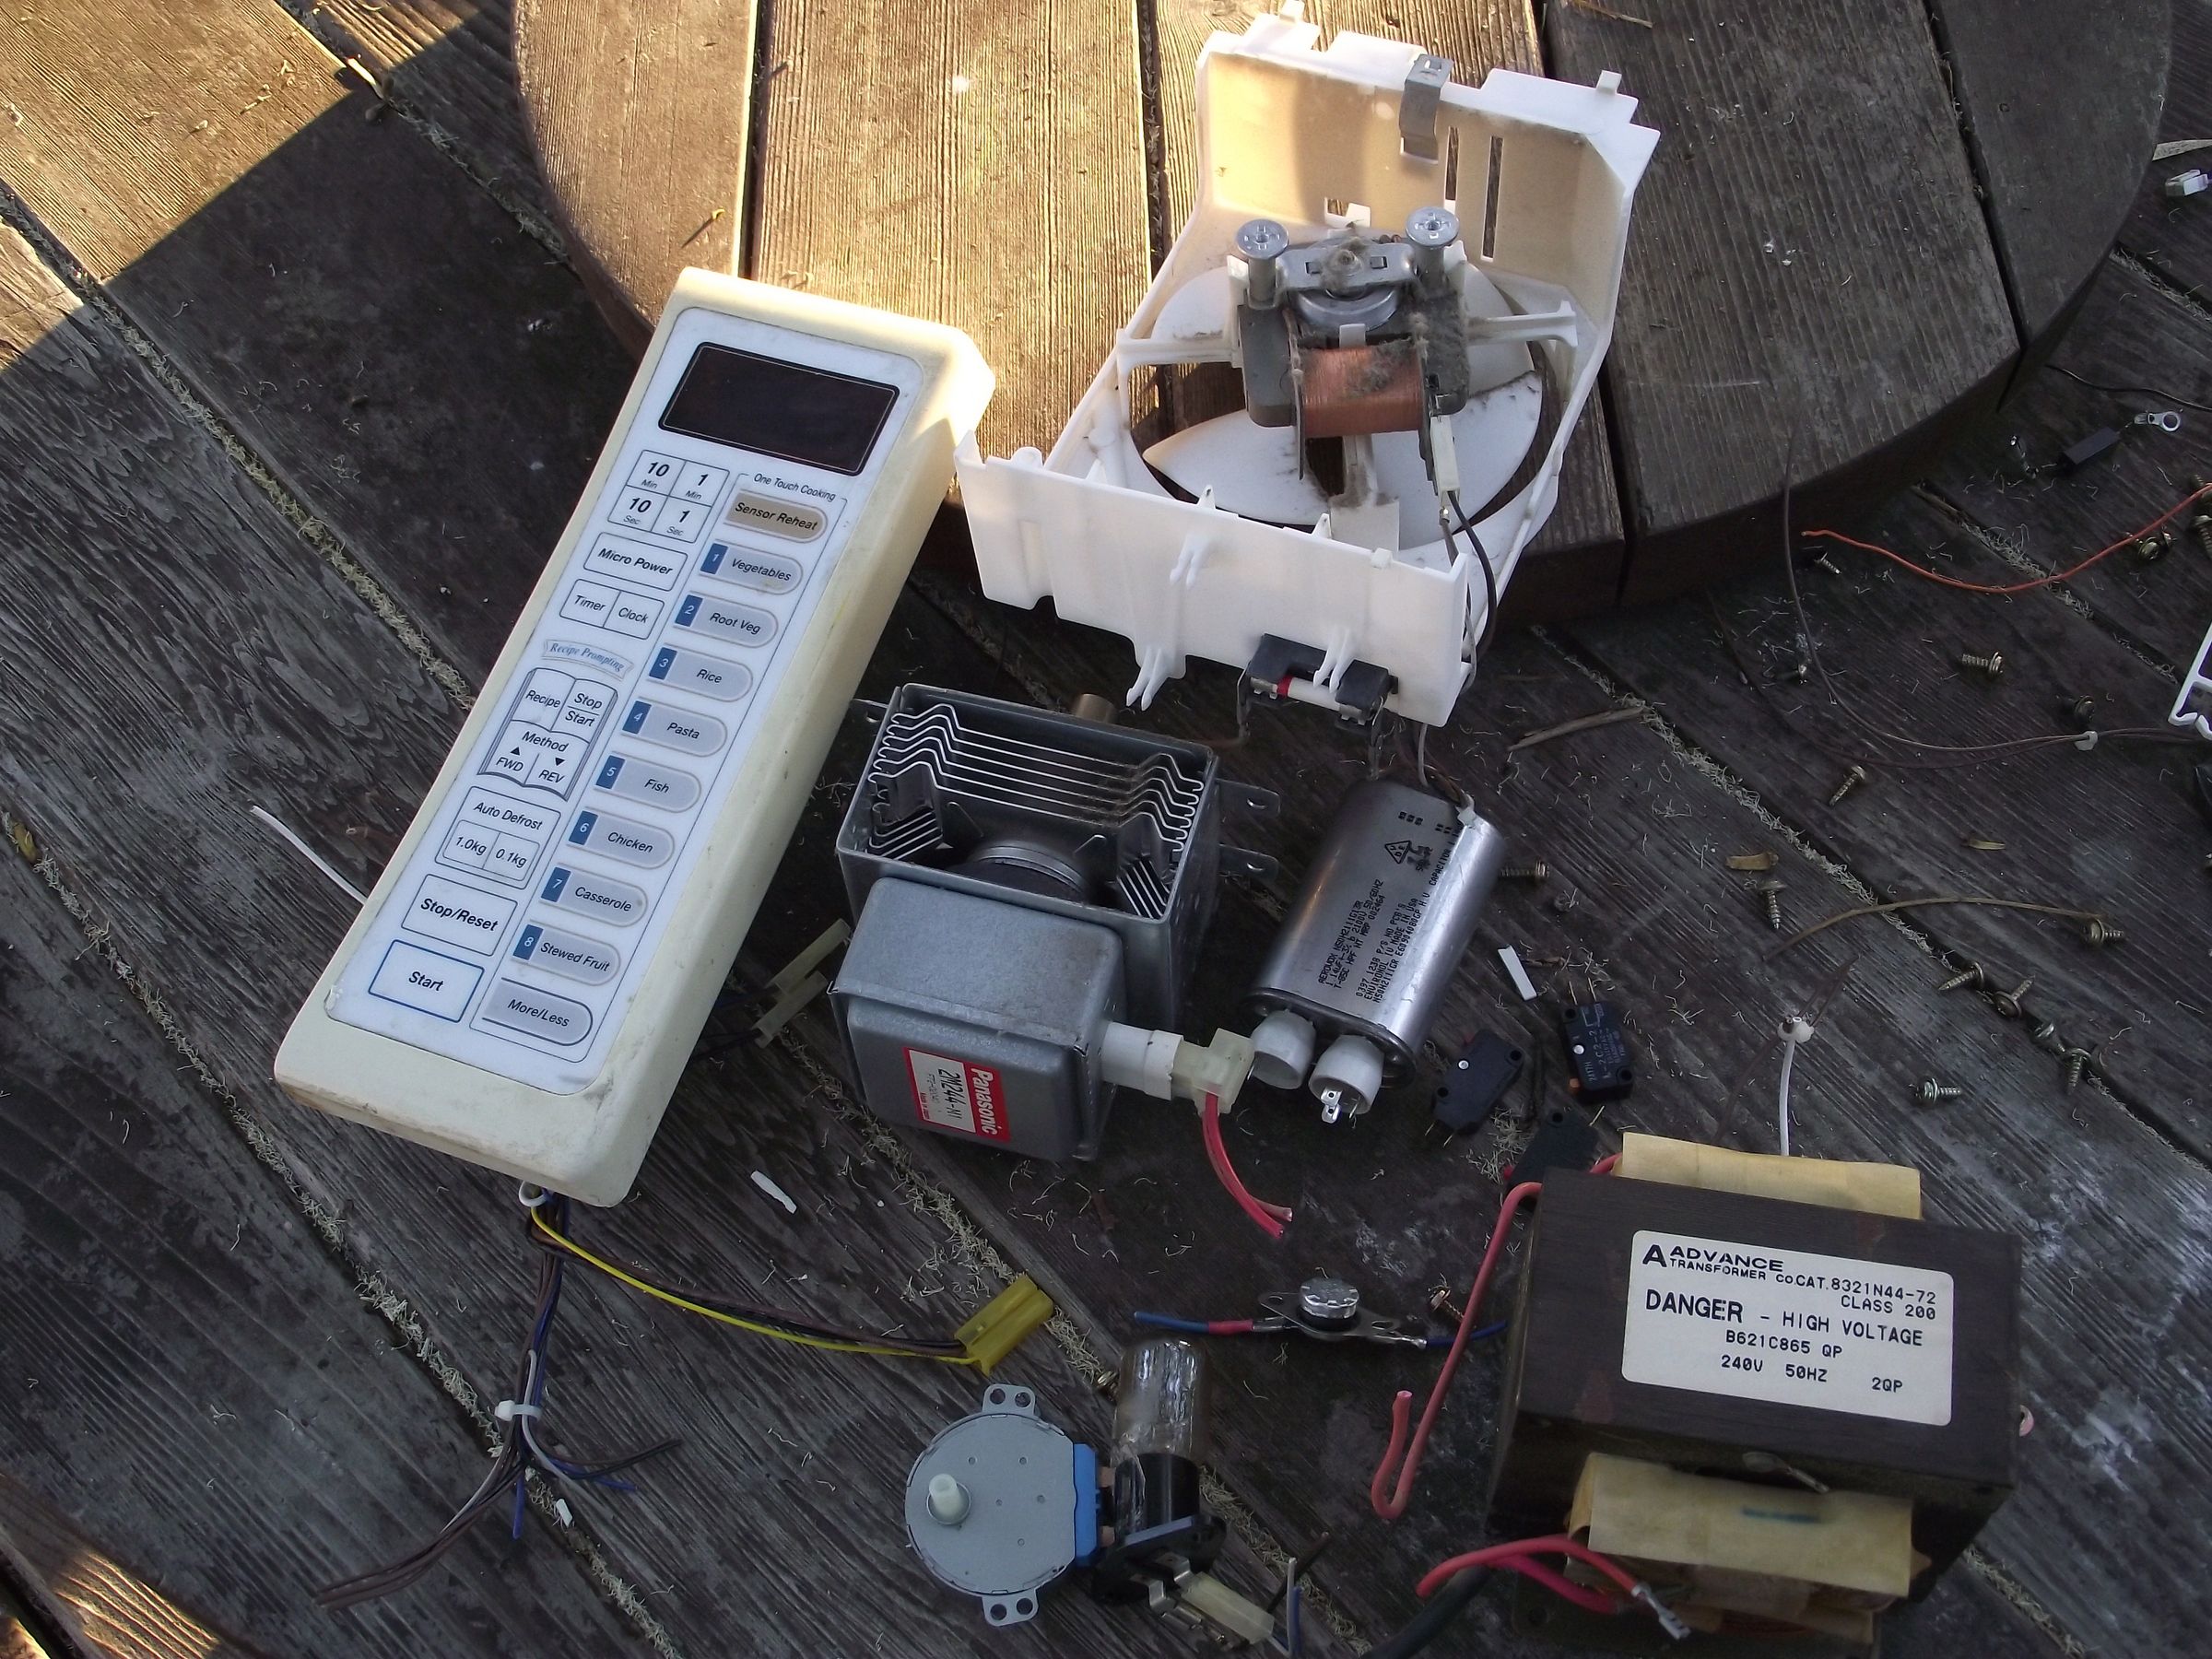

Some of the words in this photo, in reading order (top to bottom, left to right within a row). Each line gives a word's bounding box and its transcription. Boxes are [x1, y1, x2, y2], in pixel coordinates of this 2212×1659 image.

[647, 461, 670, 477] 10
[641, 479, 657, 489] Min
[697, 473, 708, 486] 1
[754, 472, 771, 485] One
[774, 477, 799, 492] Touch
[800, 485, 836, 502] Cooking
[686, 490, 702, 500] Min
[629, 497, 652, 513] 10
[623, 514, 641, 525] Sec
[678, 510, 690, 523] 1
[735, 502, 775, 519] Sensor
[776, 513, 818, 531] Reheat
[666, 526, 684, 537] Sec
[598, 547, 632, 565] Micro
[635, 558, 673, 576] Power
[731, 558, 792, 582] Vegetables
[572, 594, 606, 611] Timer
[685, 606, 693, 615] 2
[618, 606, 649, 624] Clock
[710, 613, 739, 629] Root
[741, 619, 761, 635] Veg
[550, 642, 581, 657] Recipe
[581, 647, 624, 673] Prompting
[659, 658, 668, 667] 3
[696, 669, 723, 684] Rice
[525, 690, 561, 709] Recipe
[574, 692, 603, 710] Stop
[565, 711, 595, 727] Start
[633, 712, 642, 722] 4
[667, 723, 700, 739] Pasta
[522, 731, 569, 753] Method
[496, 757, 524, 771] FWD
[606, 767, 615, 776] 5
[538, 770, 565, 783] REV
[644, 779, 669, 794] Fish
[474, 802, 500, 818] Auto
[501, 809, 543, 830] Defrost
[580, 823, 588, 832] 6
[456, 836, 487, 855] 1.0kg
[606, 831, 653, 853] Chicken
[495, 848, 527, 868] 0.1kg
[553, 879, 561, 888] 7
[575, 887, 632, 912] Casserole
[420, 898, 499, 932] Stop/Reset
[524, 936, 534, 947] 8
[540, 942, 582, 963] Stewed
[583, 954, 610, 971] Fruit
[408, 971, 443, 992] Start
[507, 998, 570, 1026] More/Less
[971, 1068, 1002, 1135] Panasonic
[1670, 1245, 1783, 1272] ADVANCE
[1669, 1259, 1767, 1280] TRANSFORMER
[1841, 1296, 1893, 1313] CLASS
[1905, 1305, 1936, 1320] 200
[1646, 1289, 1743, 1323] DANGER
[1783, 1312, 1830, 1333] HIGH
[1842, 1320, 1923, 1346] VOLTAGE
[1726, 1330, 1810, 1354] B621C865
[1821, 1345, 1842, 1358] QP
[1722, 1356, 1762, 1372] 240V
[1785, 1364, 1828, 1382] 50HZ
[1872, 1377, 1903, 1393] 2QP
